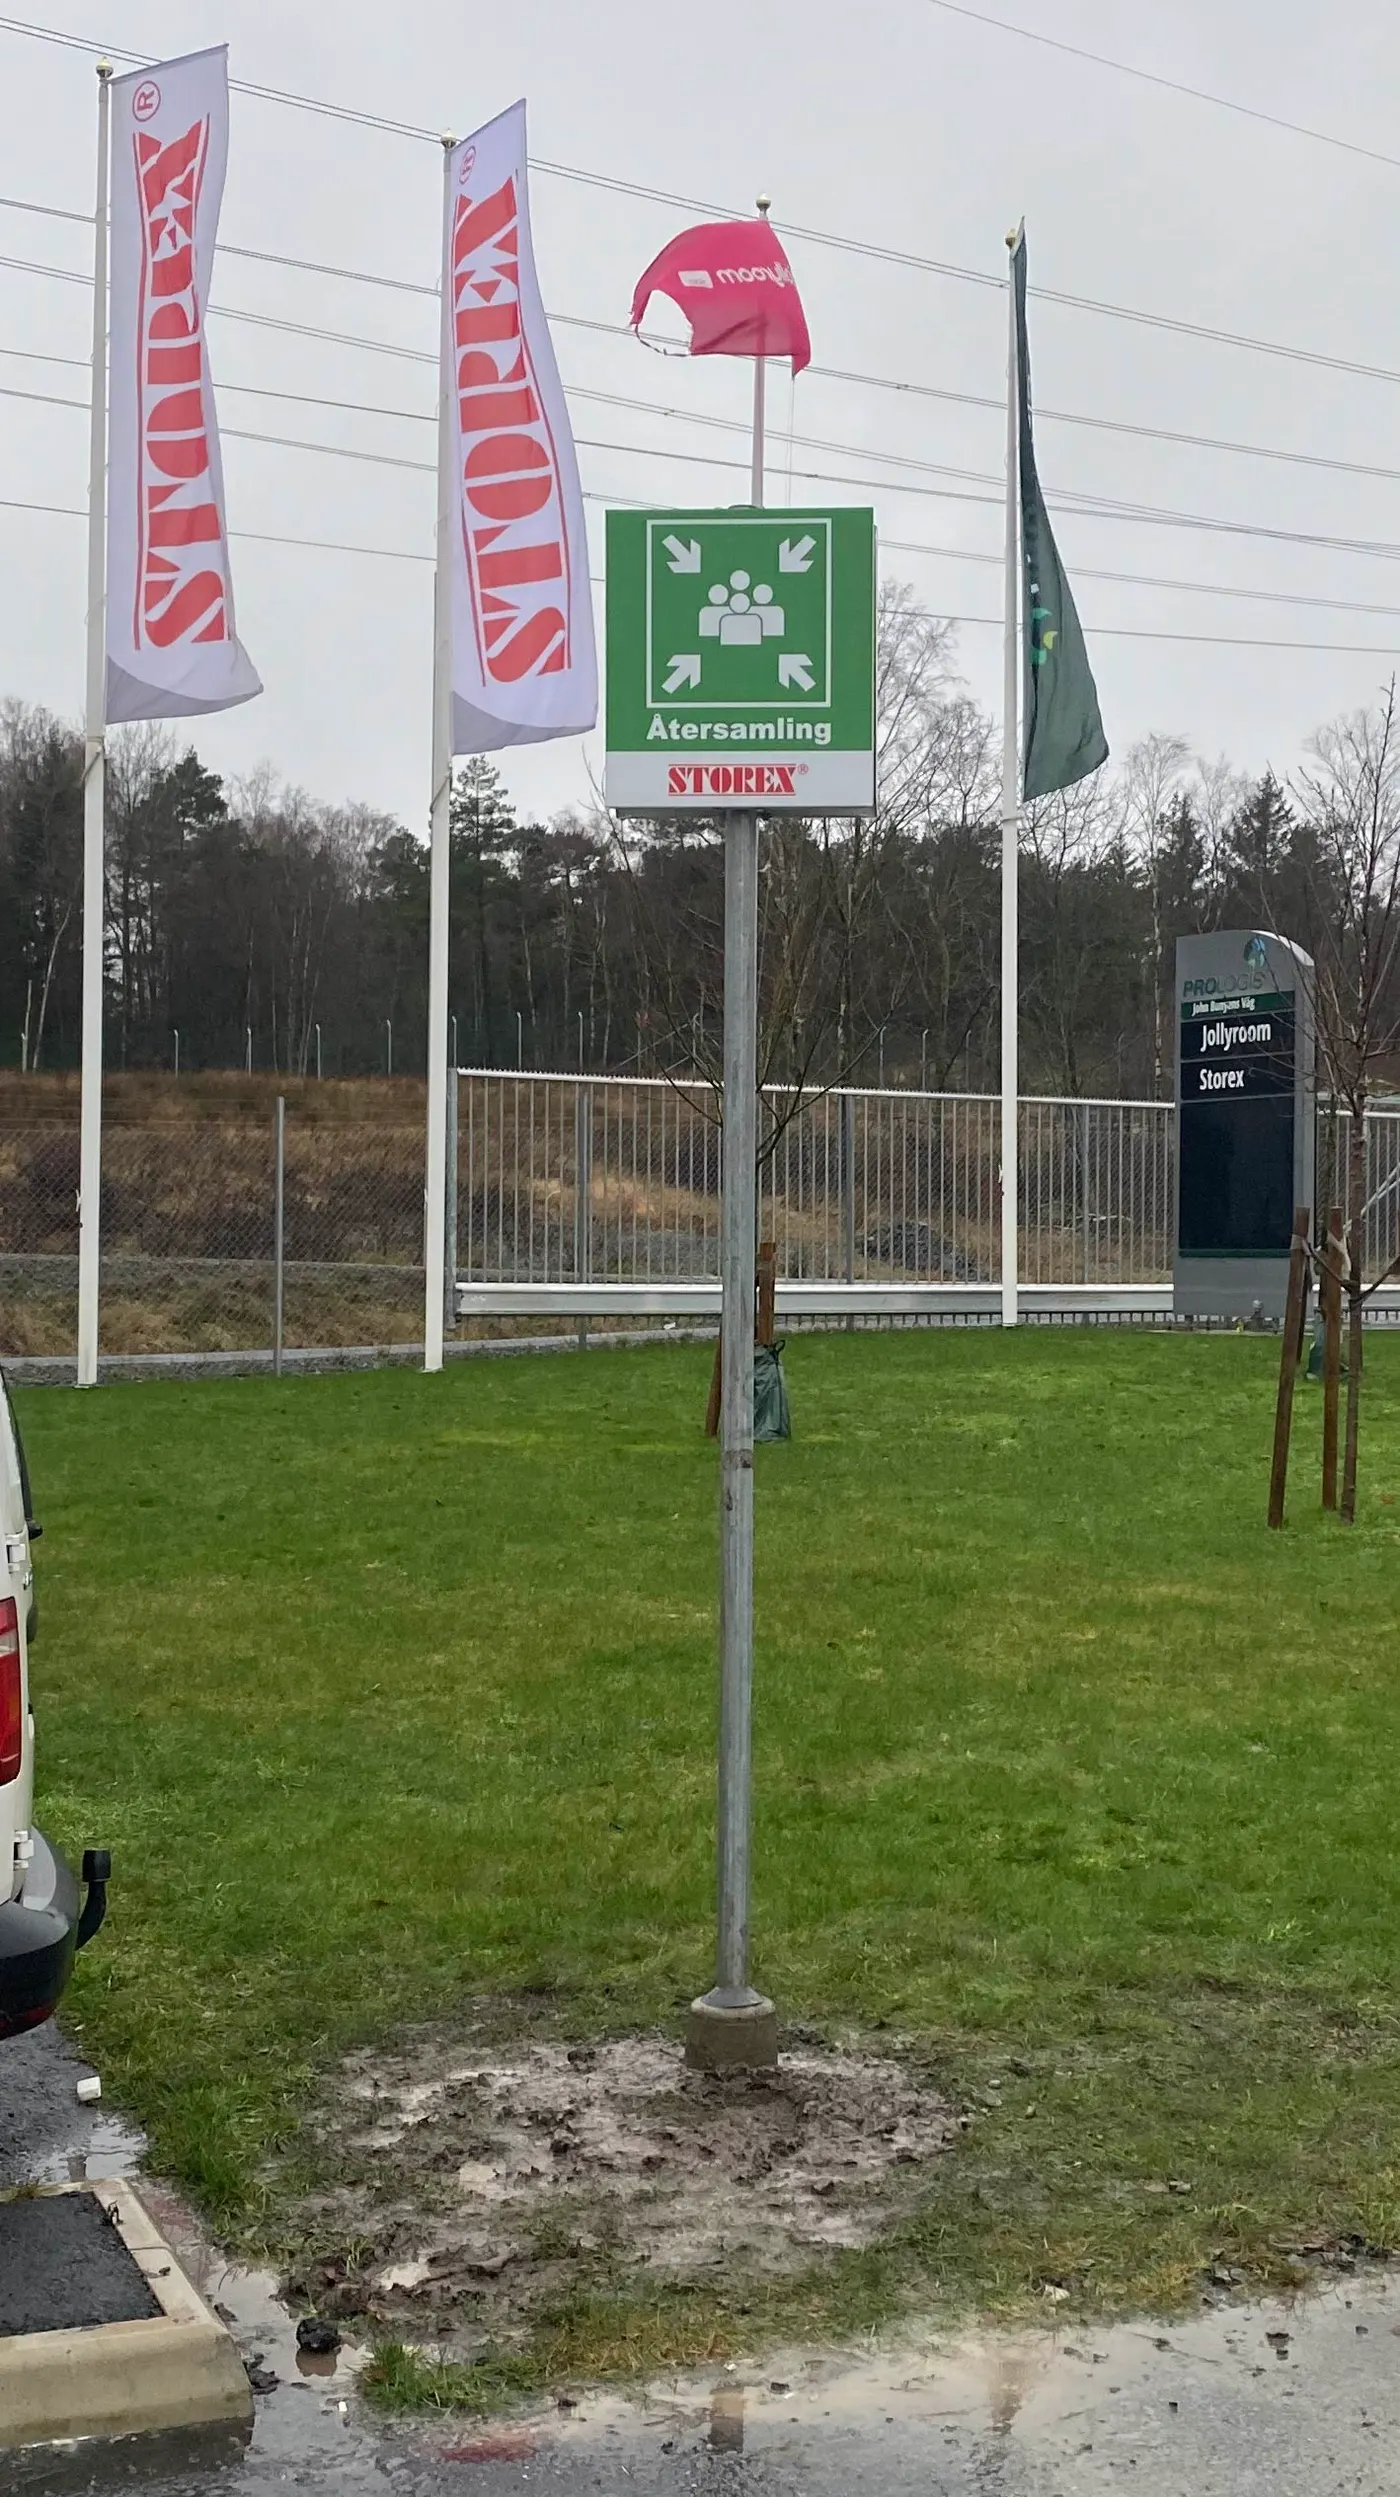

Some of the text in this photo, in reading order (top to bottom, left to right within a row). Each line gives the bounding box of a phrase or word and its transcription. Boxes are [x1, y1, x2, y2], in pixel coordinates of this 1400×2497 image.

[646, 713, 832, 745] Återsamling
[1191, 996, 1256, 1017] John Bunyans Väg
[1200, 1022, 1271, 1052] Jollyroom
[1199, 1068, 1245, 1091] Storex
